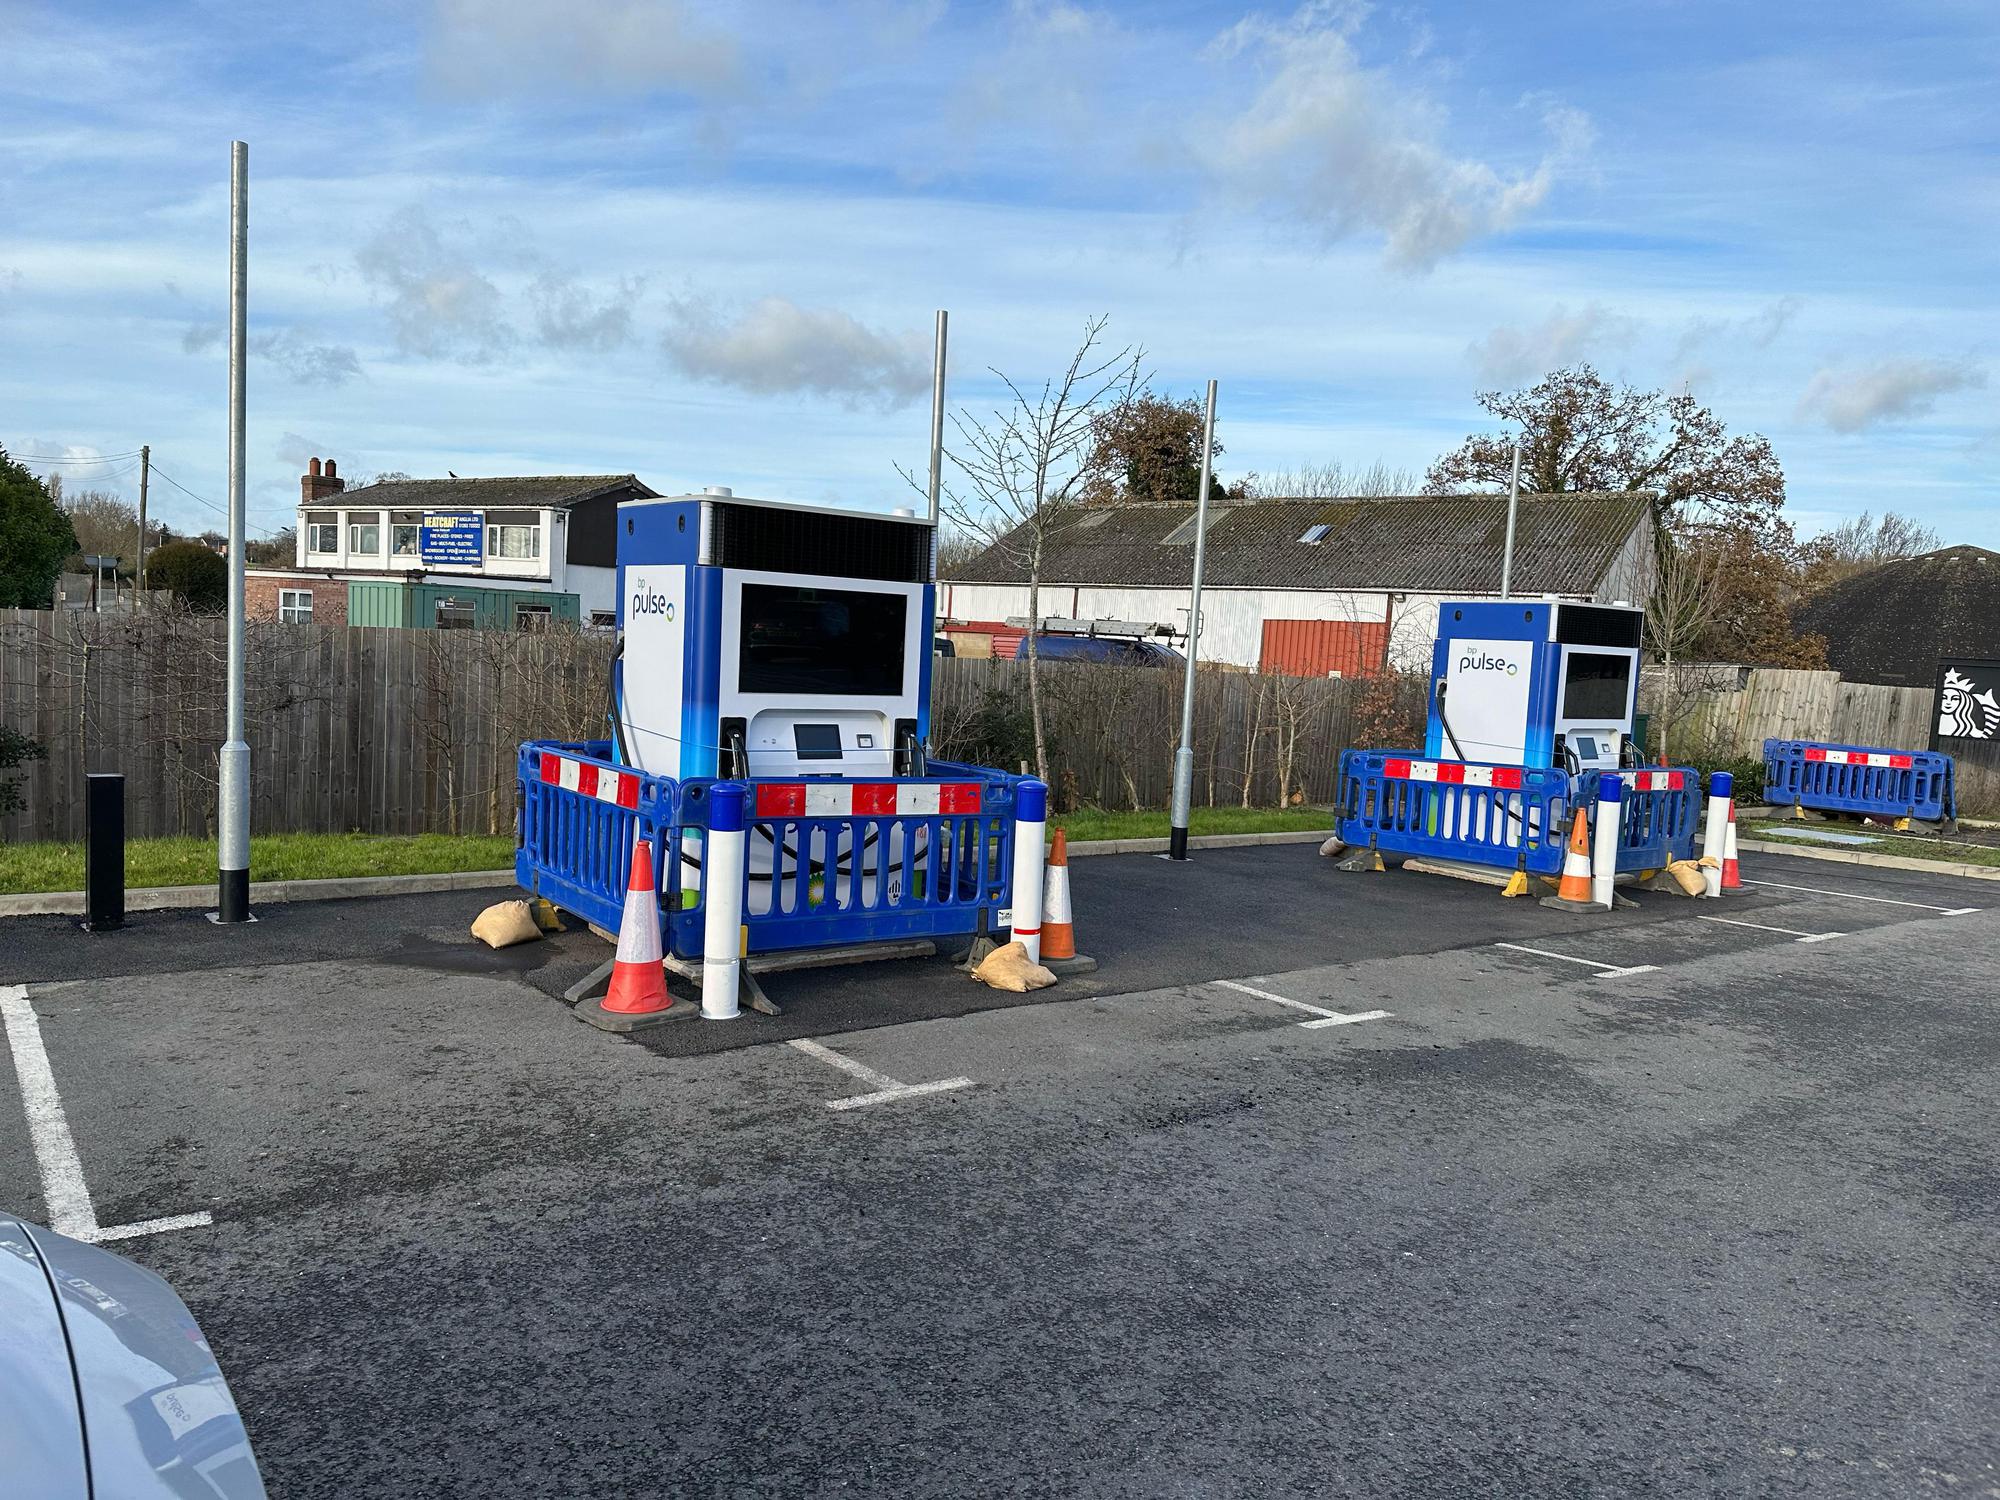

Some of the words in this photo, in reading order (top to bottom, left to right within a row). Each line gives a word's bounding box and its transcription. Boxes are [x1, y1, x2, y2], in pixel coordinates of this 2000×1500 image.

[424, 517, 459, 528] HEATCRAFT
[637, 576, 646, 591] bp
[632, 585, 666, 620] pulse
[1467, 646, 1478, 655] bp
[1459, 652, 1506, 673] pulse
